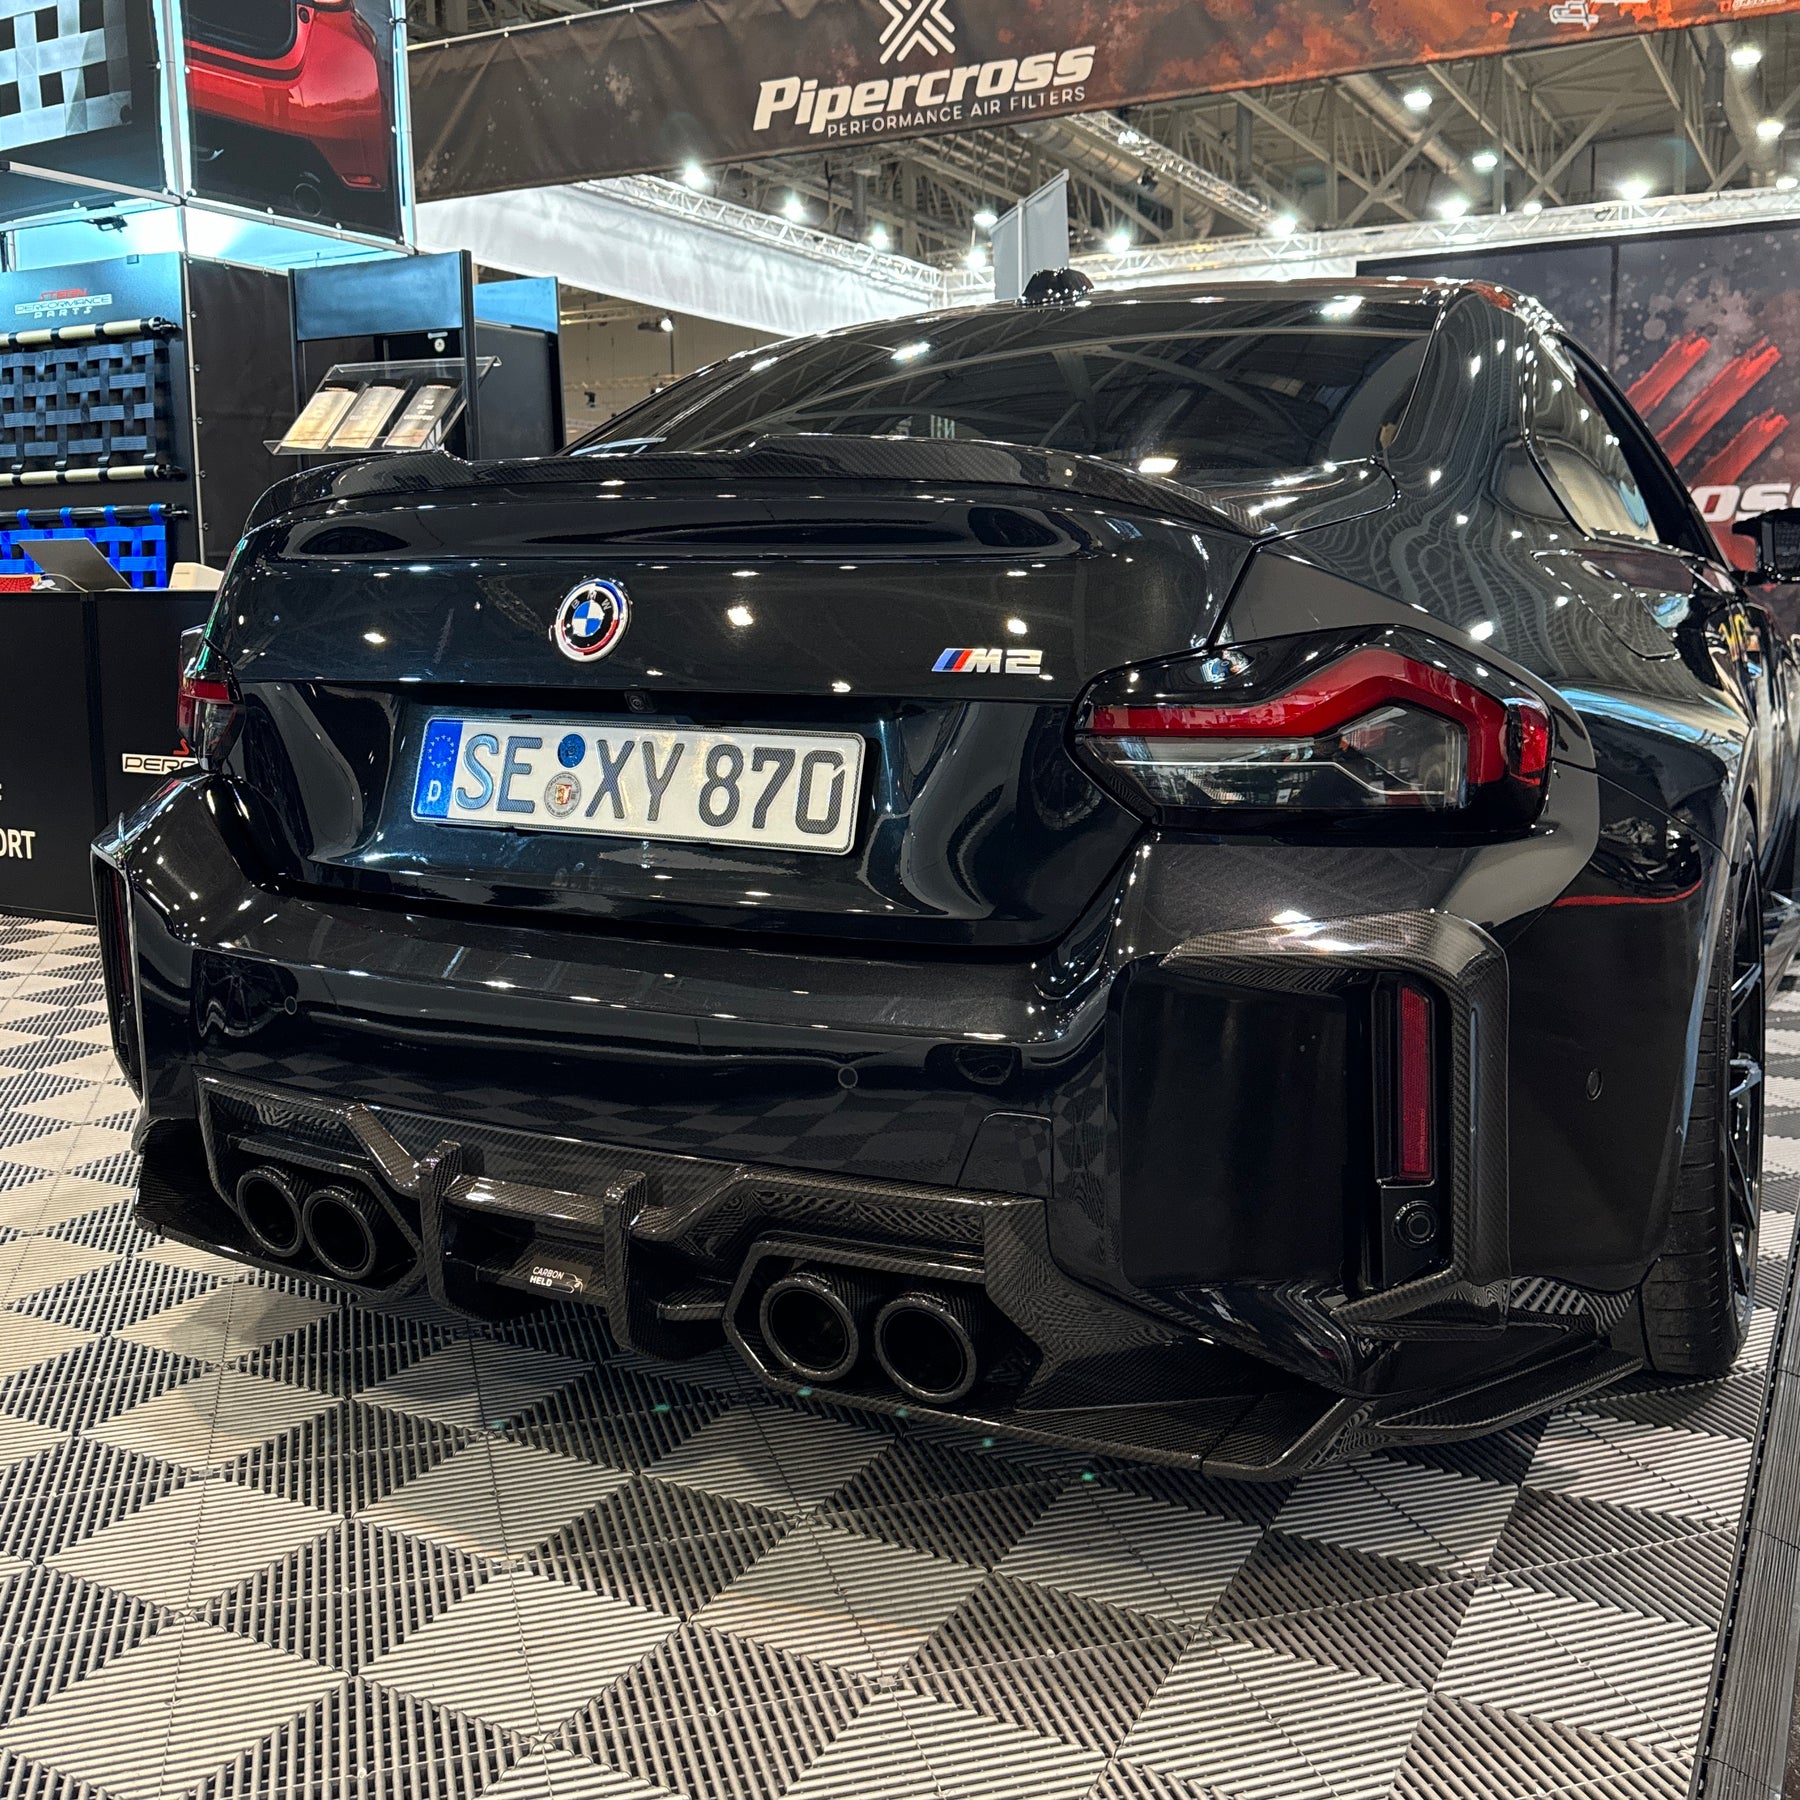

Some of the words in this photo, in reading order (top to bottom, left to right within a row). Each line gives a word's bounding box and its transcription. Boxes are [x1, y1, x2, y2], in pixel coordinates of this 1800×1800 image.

[753, 46, 1096, 134] Pipercross
[826, 108, 963, 138] PERFORMANCE
[969, 98, 1001, 118] AIR
[1008, 86, 1086, 112] FILTERS
[16, 295, 110, 312] PERFORMANCE
[33, 306, 93, 319] PARTS
[570, 588, 612, 611] BMW
[960, 648, 1043, 674] M2
[427, 780, 442, 802] D
[454, 733, 543, 815] SE
[584, 739, 685, 822] XY
[697, 744, 843, 835] 870
[529, 1275, 553, 1287] HELD
[532, 1266, 565, 1280] CARBON
